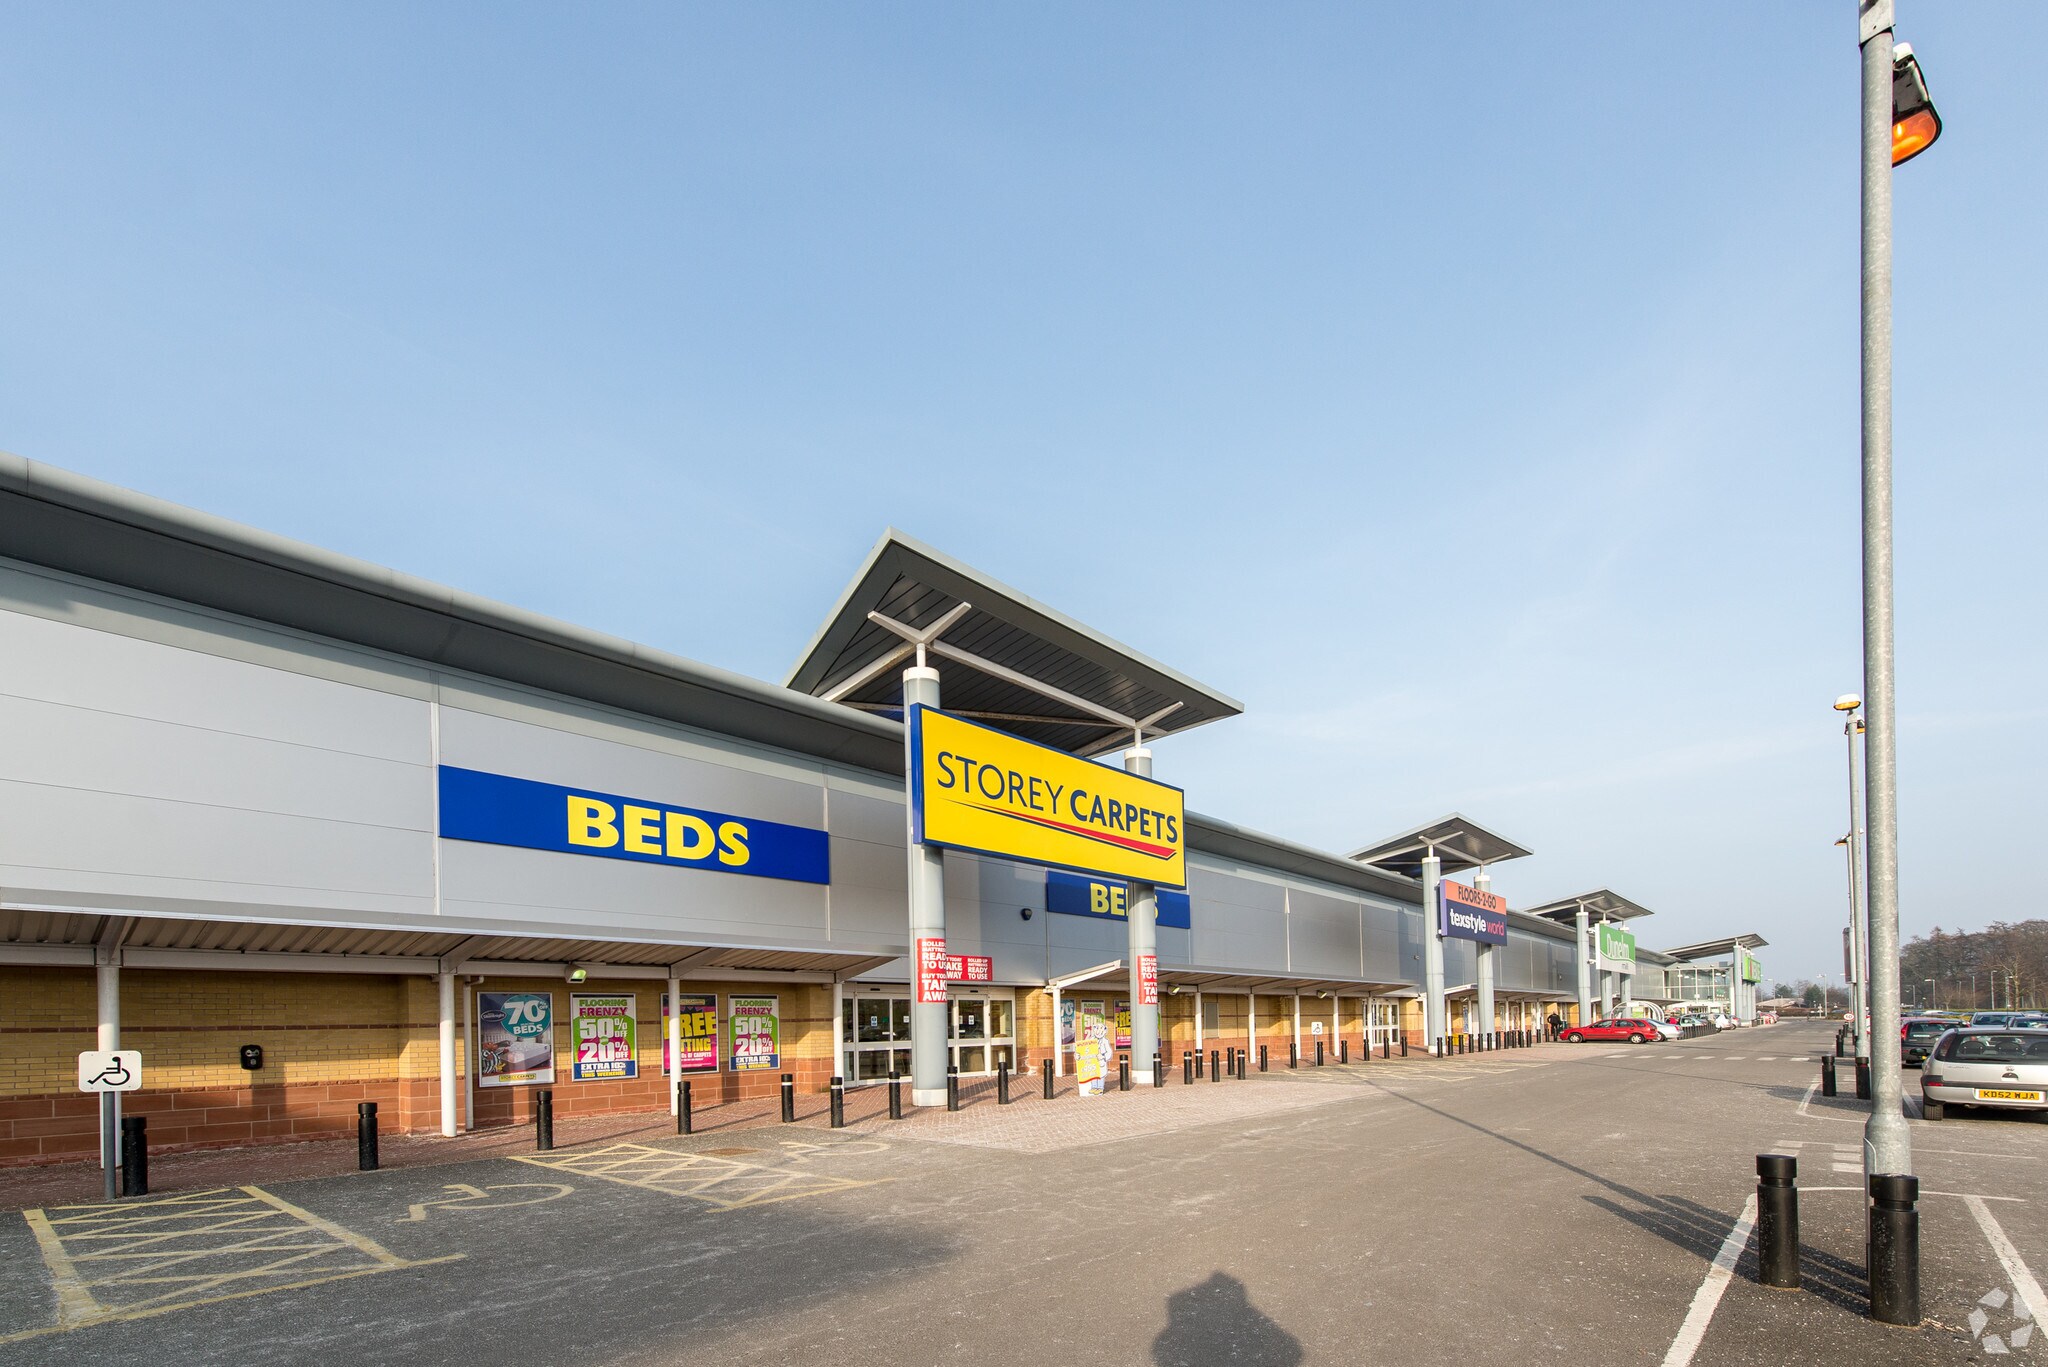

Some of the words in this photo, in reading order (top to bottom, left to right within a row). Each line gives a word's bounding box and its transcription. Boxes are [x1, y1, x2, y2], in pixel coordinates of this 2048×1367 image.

[937, 751, 1064, 815] STOREY
[1070, 789, 1178, 843] CARPETS
[567, 795, 750, 866] BEDS
[1458, 886, 1496, 909] FLOORS-2-GO
[1450, 908, 1486, 934] texstyle
[1487, 922, 1504, 936] world
[1606, 933, 1629, 959] Dunelm
[922, 961, 937, 969] TO
[946, 963, 963, 971] AKE
[946, 971, 963, 979] WAY
[579, 999, 628, 1007] FLOORING
[579, 1007, 628, 1016] FRENZY
[735, 1007, 773, 1015] FRENZY
[513, 1024, 543, 1034] BEDS
[614, 1030, 628, 1038] OFF
